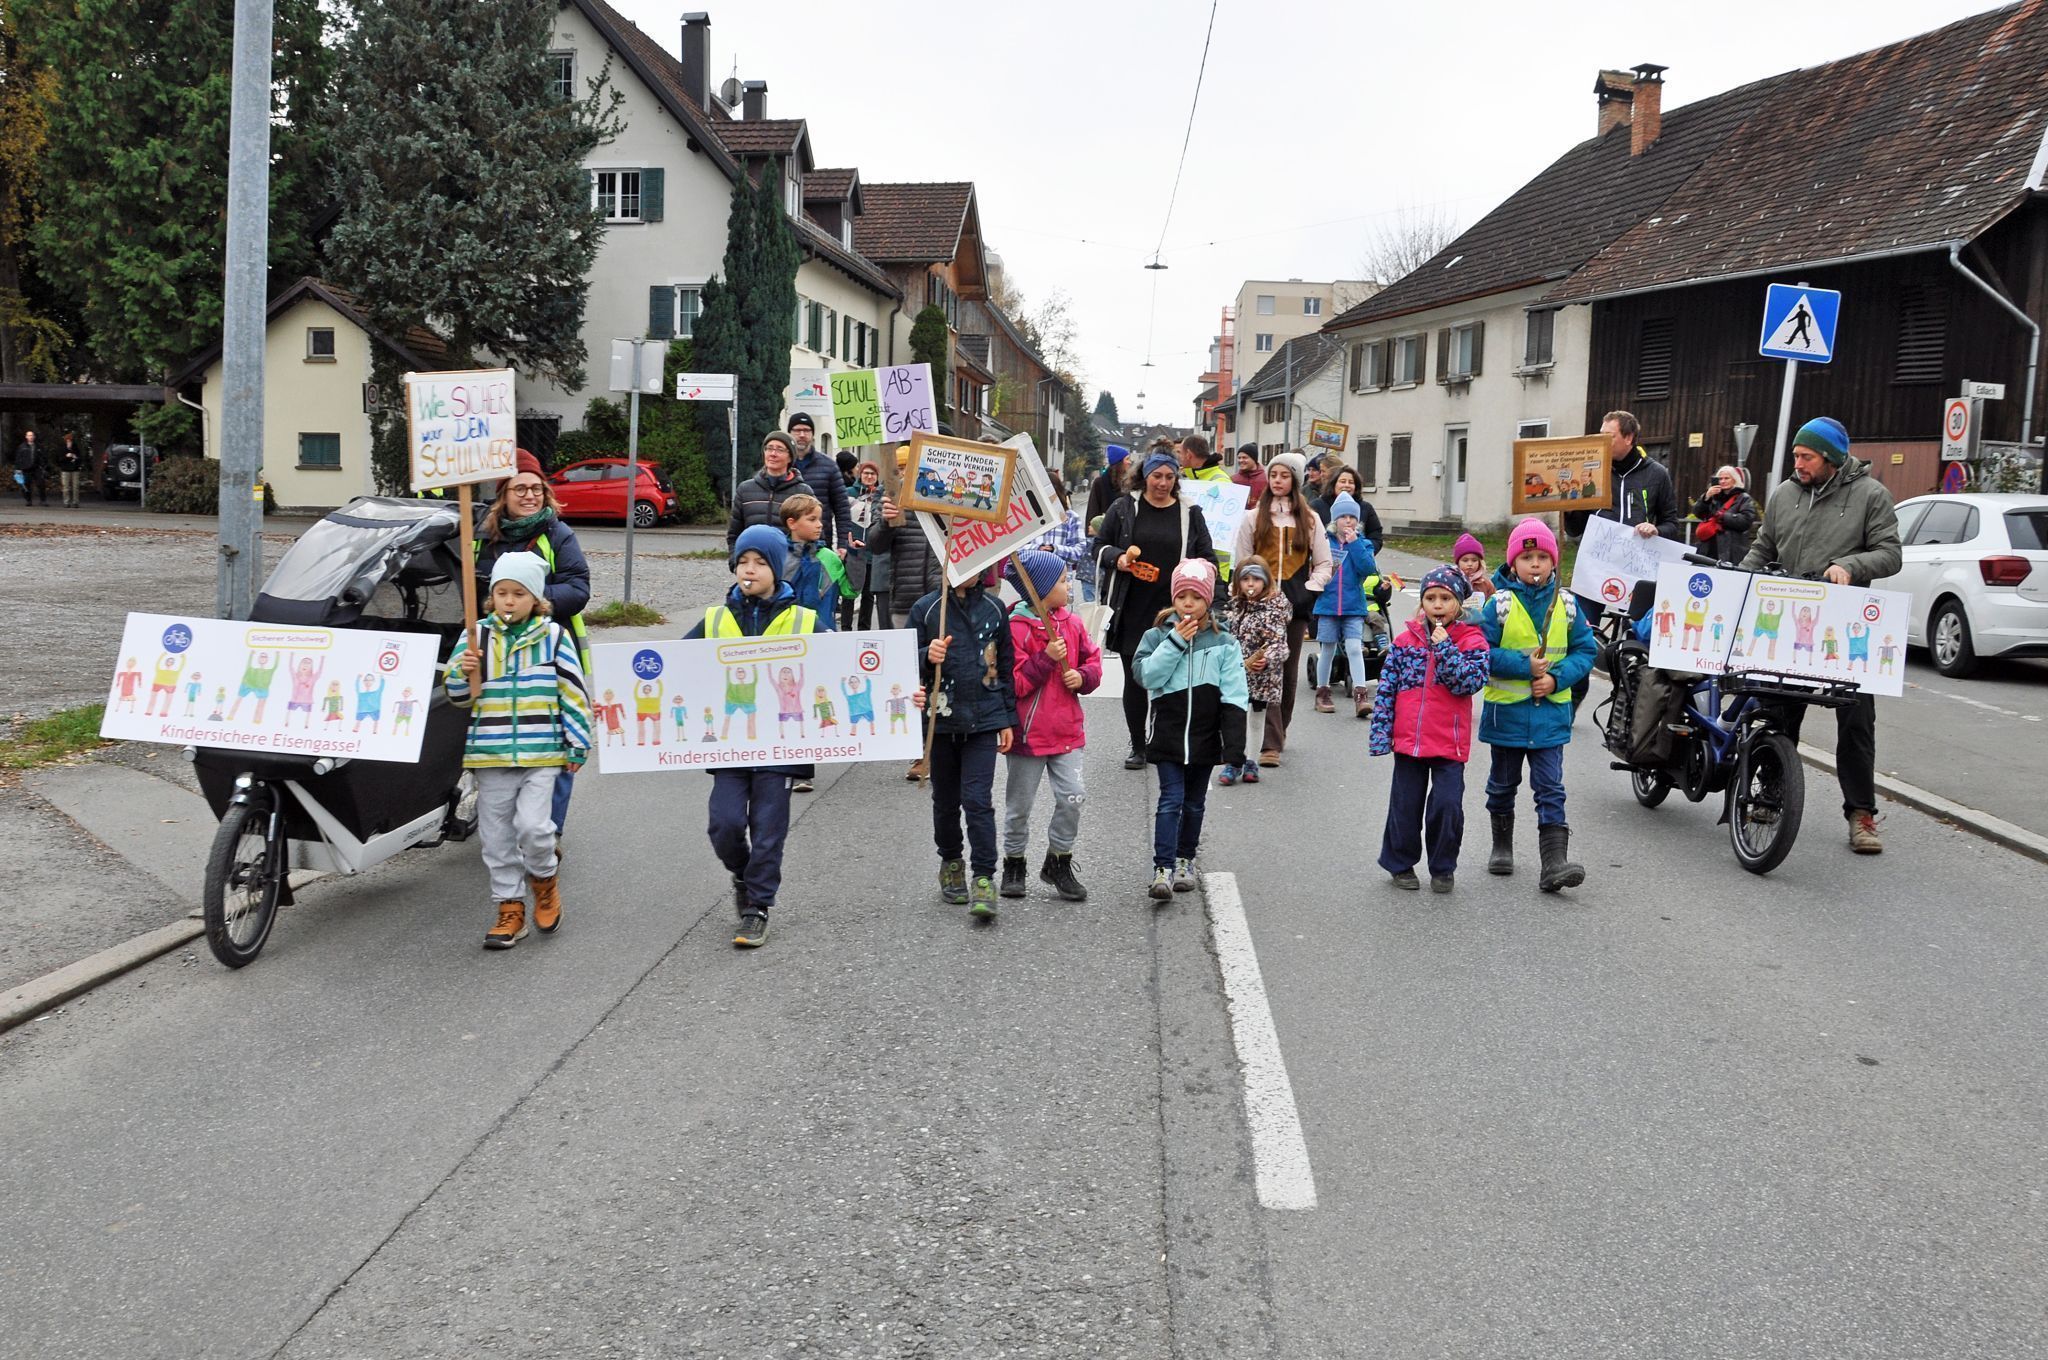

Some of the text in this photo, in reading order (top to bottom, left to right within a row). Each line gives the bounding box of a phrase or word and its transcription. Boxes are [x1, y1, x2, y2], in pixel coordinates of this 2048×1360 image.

[885, 368, 921, 397] AB-
[831, 379, 877, 405] SCHUL-
[418, 382, 511, 420] Wie SICHER
[1952, 412, 1962, 430] 30
[927, 448, 962, 461] SCHÜTZT
[1946, 443, 1962, 457] Zone
[926, 456, 998, 475] NICHT DEN VERKEHR!
[251, 634, 284, 642] Sicherer
[385, 642, 400, 651] ZONE
[722, 643, 801, 658] Sicherer Schulweg!
[862, 642, 878, 650] ZONE
[383, 656, 395, 667] 30
[864, 656, 876, 666] 30
[160, 723, 361, 754] Kindersichere Eisengasse!
[658, 742, 863, 766] Kindersichere Eisengasse!
